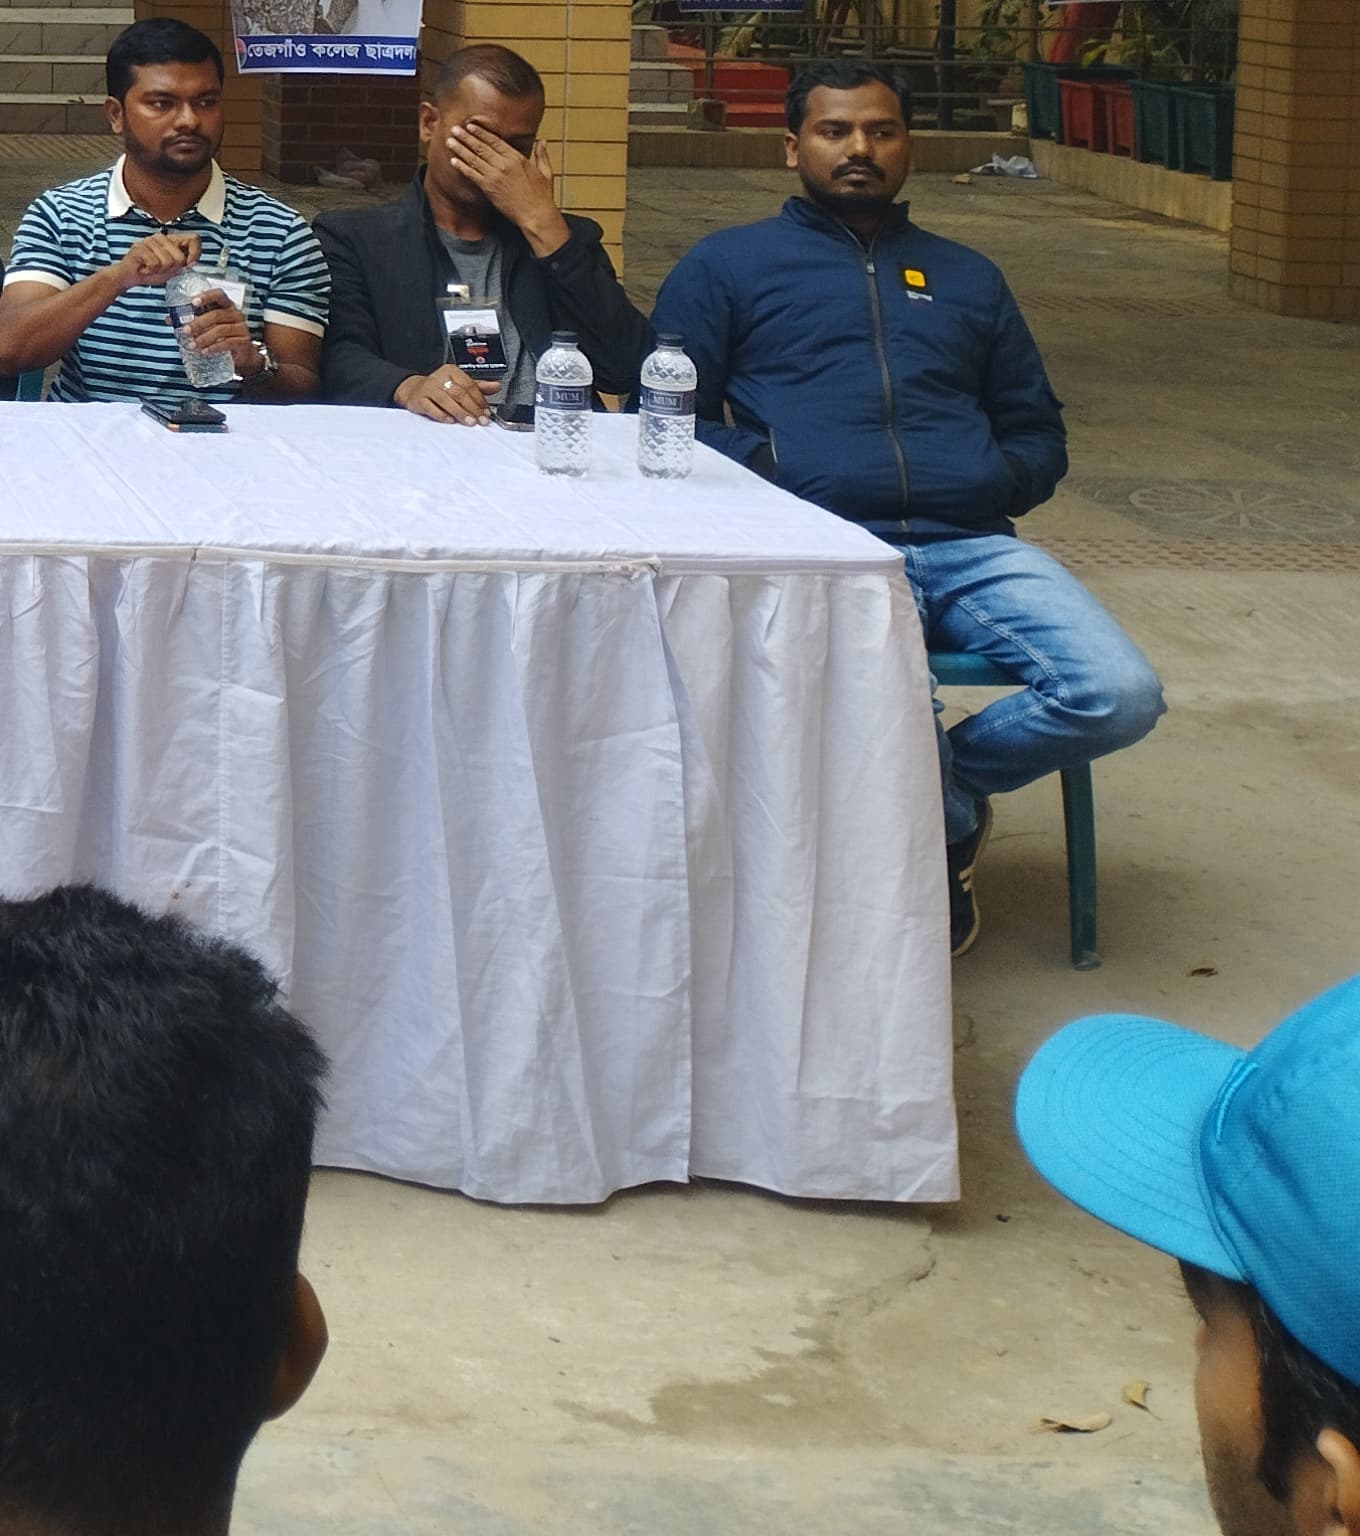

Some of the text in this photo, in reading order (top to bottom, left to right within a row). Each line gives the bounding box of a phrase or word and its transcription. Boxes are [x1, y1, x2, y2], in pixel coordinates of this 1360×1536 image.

[247, 38, 360, 62] তেজগাঁও কলেজ
[555, 393, 579, 402] MUM
[653, 395, 677, 406] MUM
